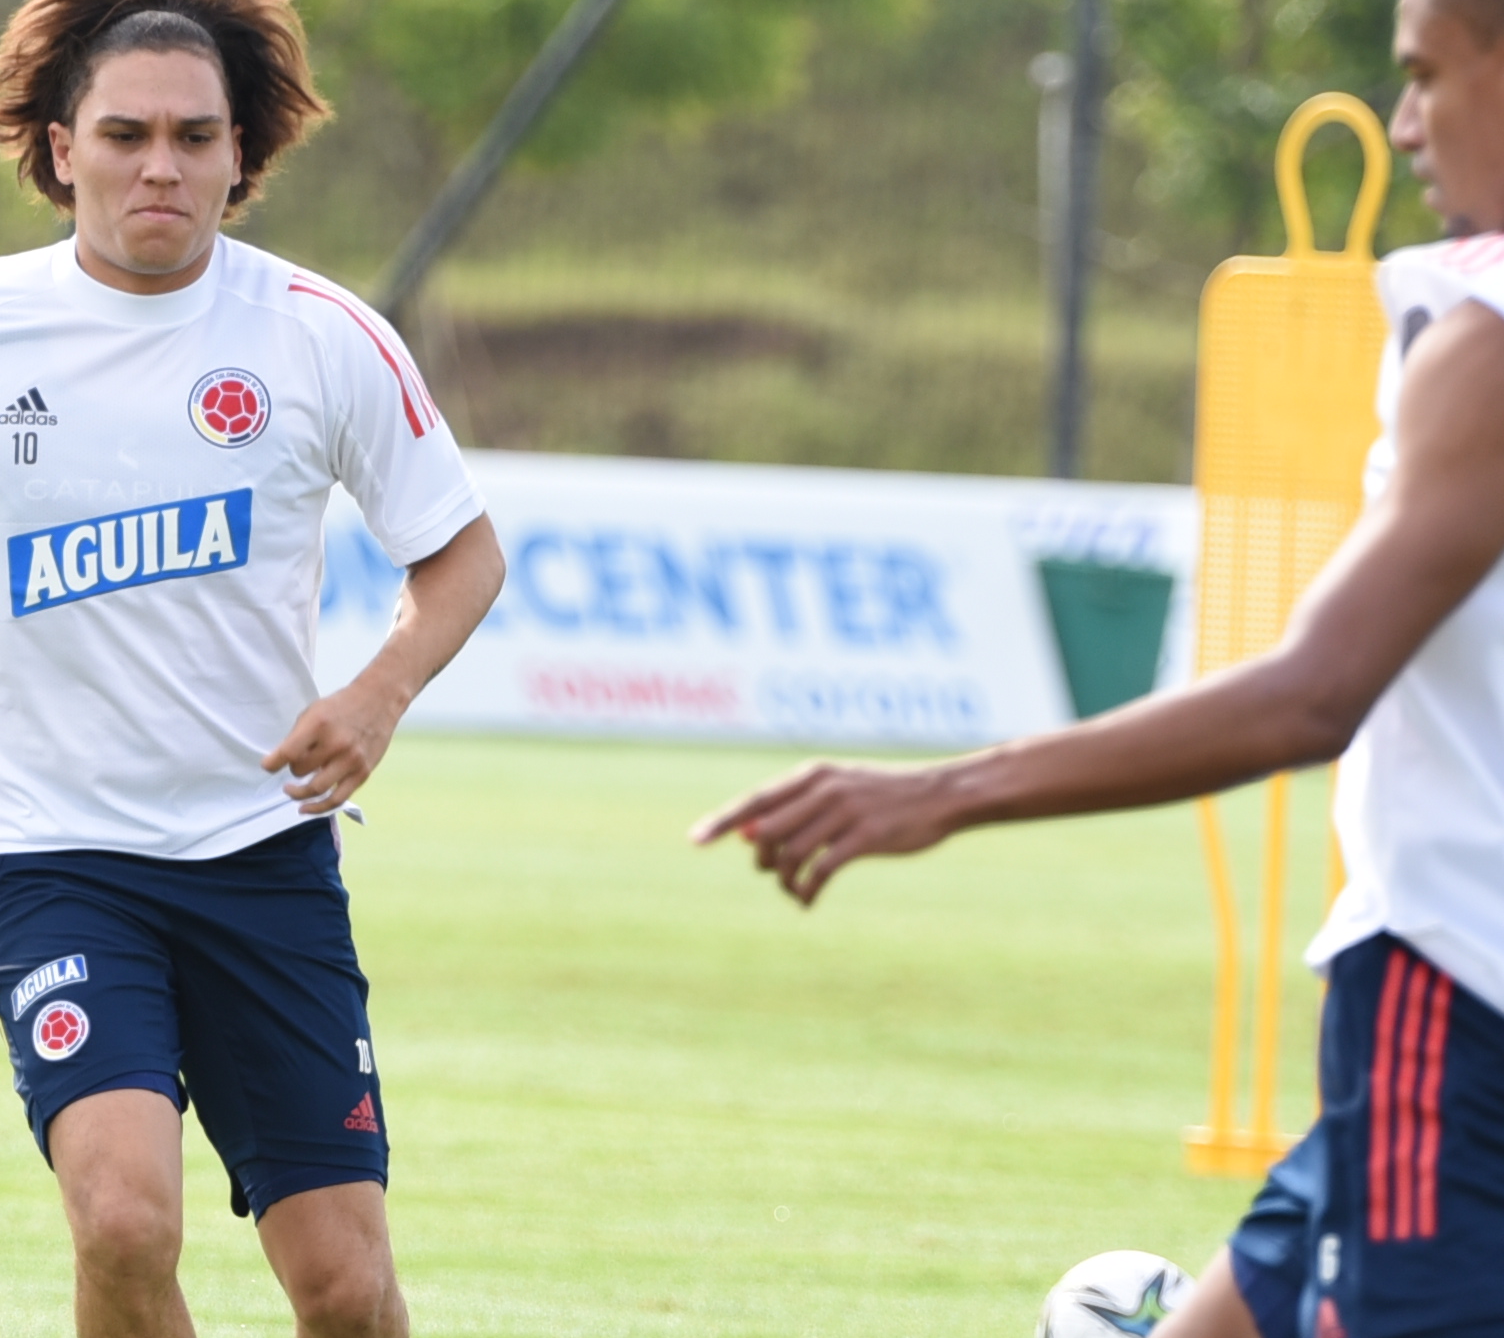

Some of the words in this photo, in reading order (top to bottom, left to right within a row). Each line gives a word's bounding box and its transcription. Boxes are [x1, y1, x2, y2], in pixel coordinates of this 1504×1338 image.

[12, 431, 38, 465] 10
[23, 499, 237, 608] AGUILA
[17, 959, 81, 1014] AGUILA
[355, 1037, 372, 1074] 10
